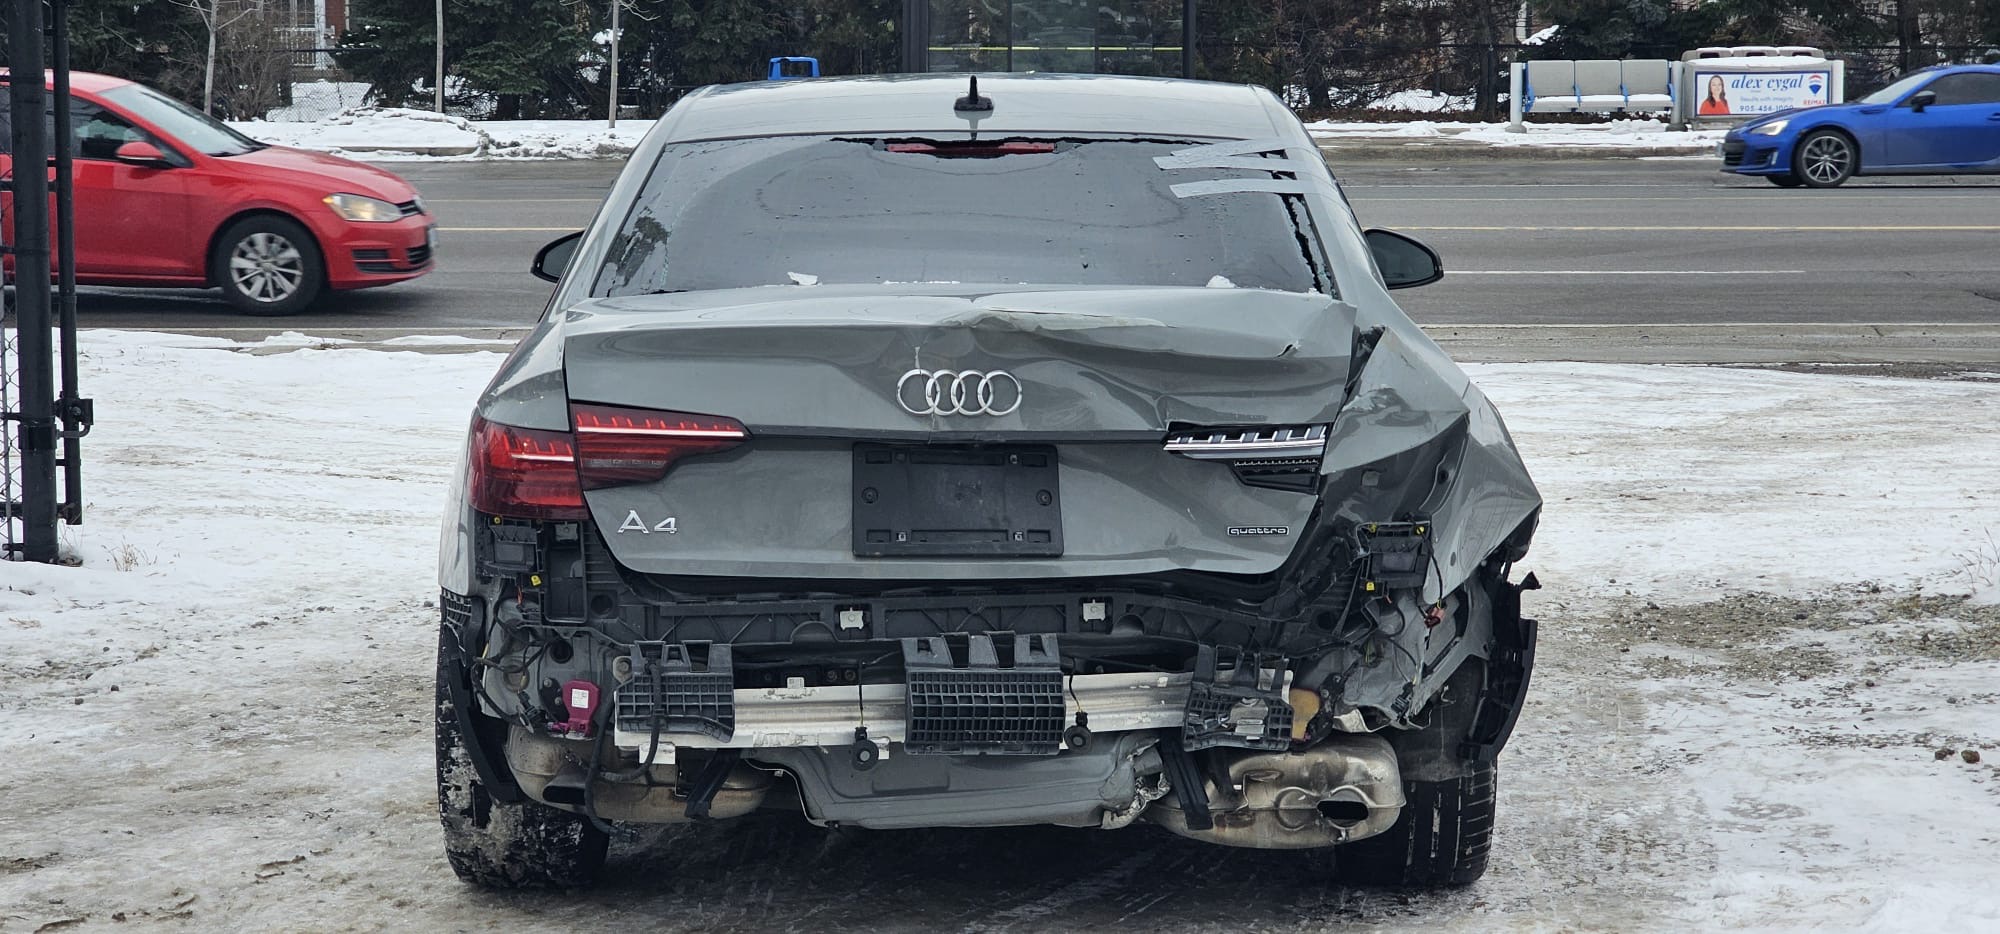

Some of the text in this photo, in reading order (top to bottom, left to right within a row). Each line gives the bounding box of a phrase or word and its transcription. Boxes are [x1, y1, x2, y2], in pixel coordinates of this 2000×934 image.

[1731, 75, 1804, 92] alex cygal
[1230, 527, 1287, 535] quattro
